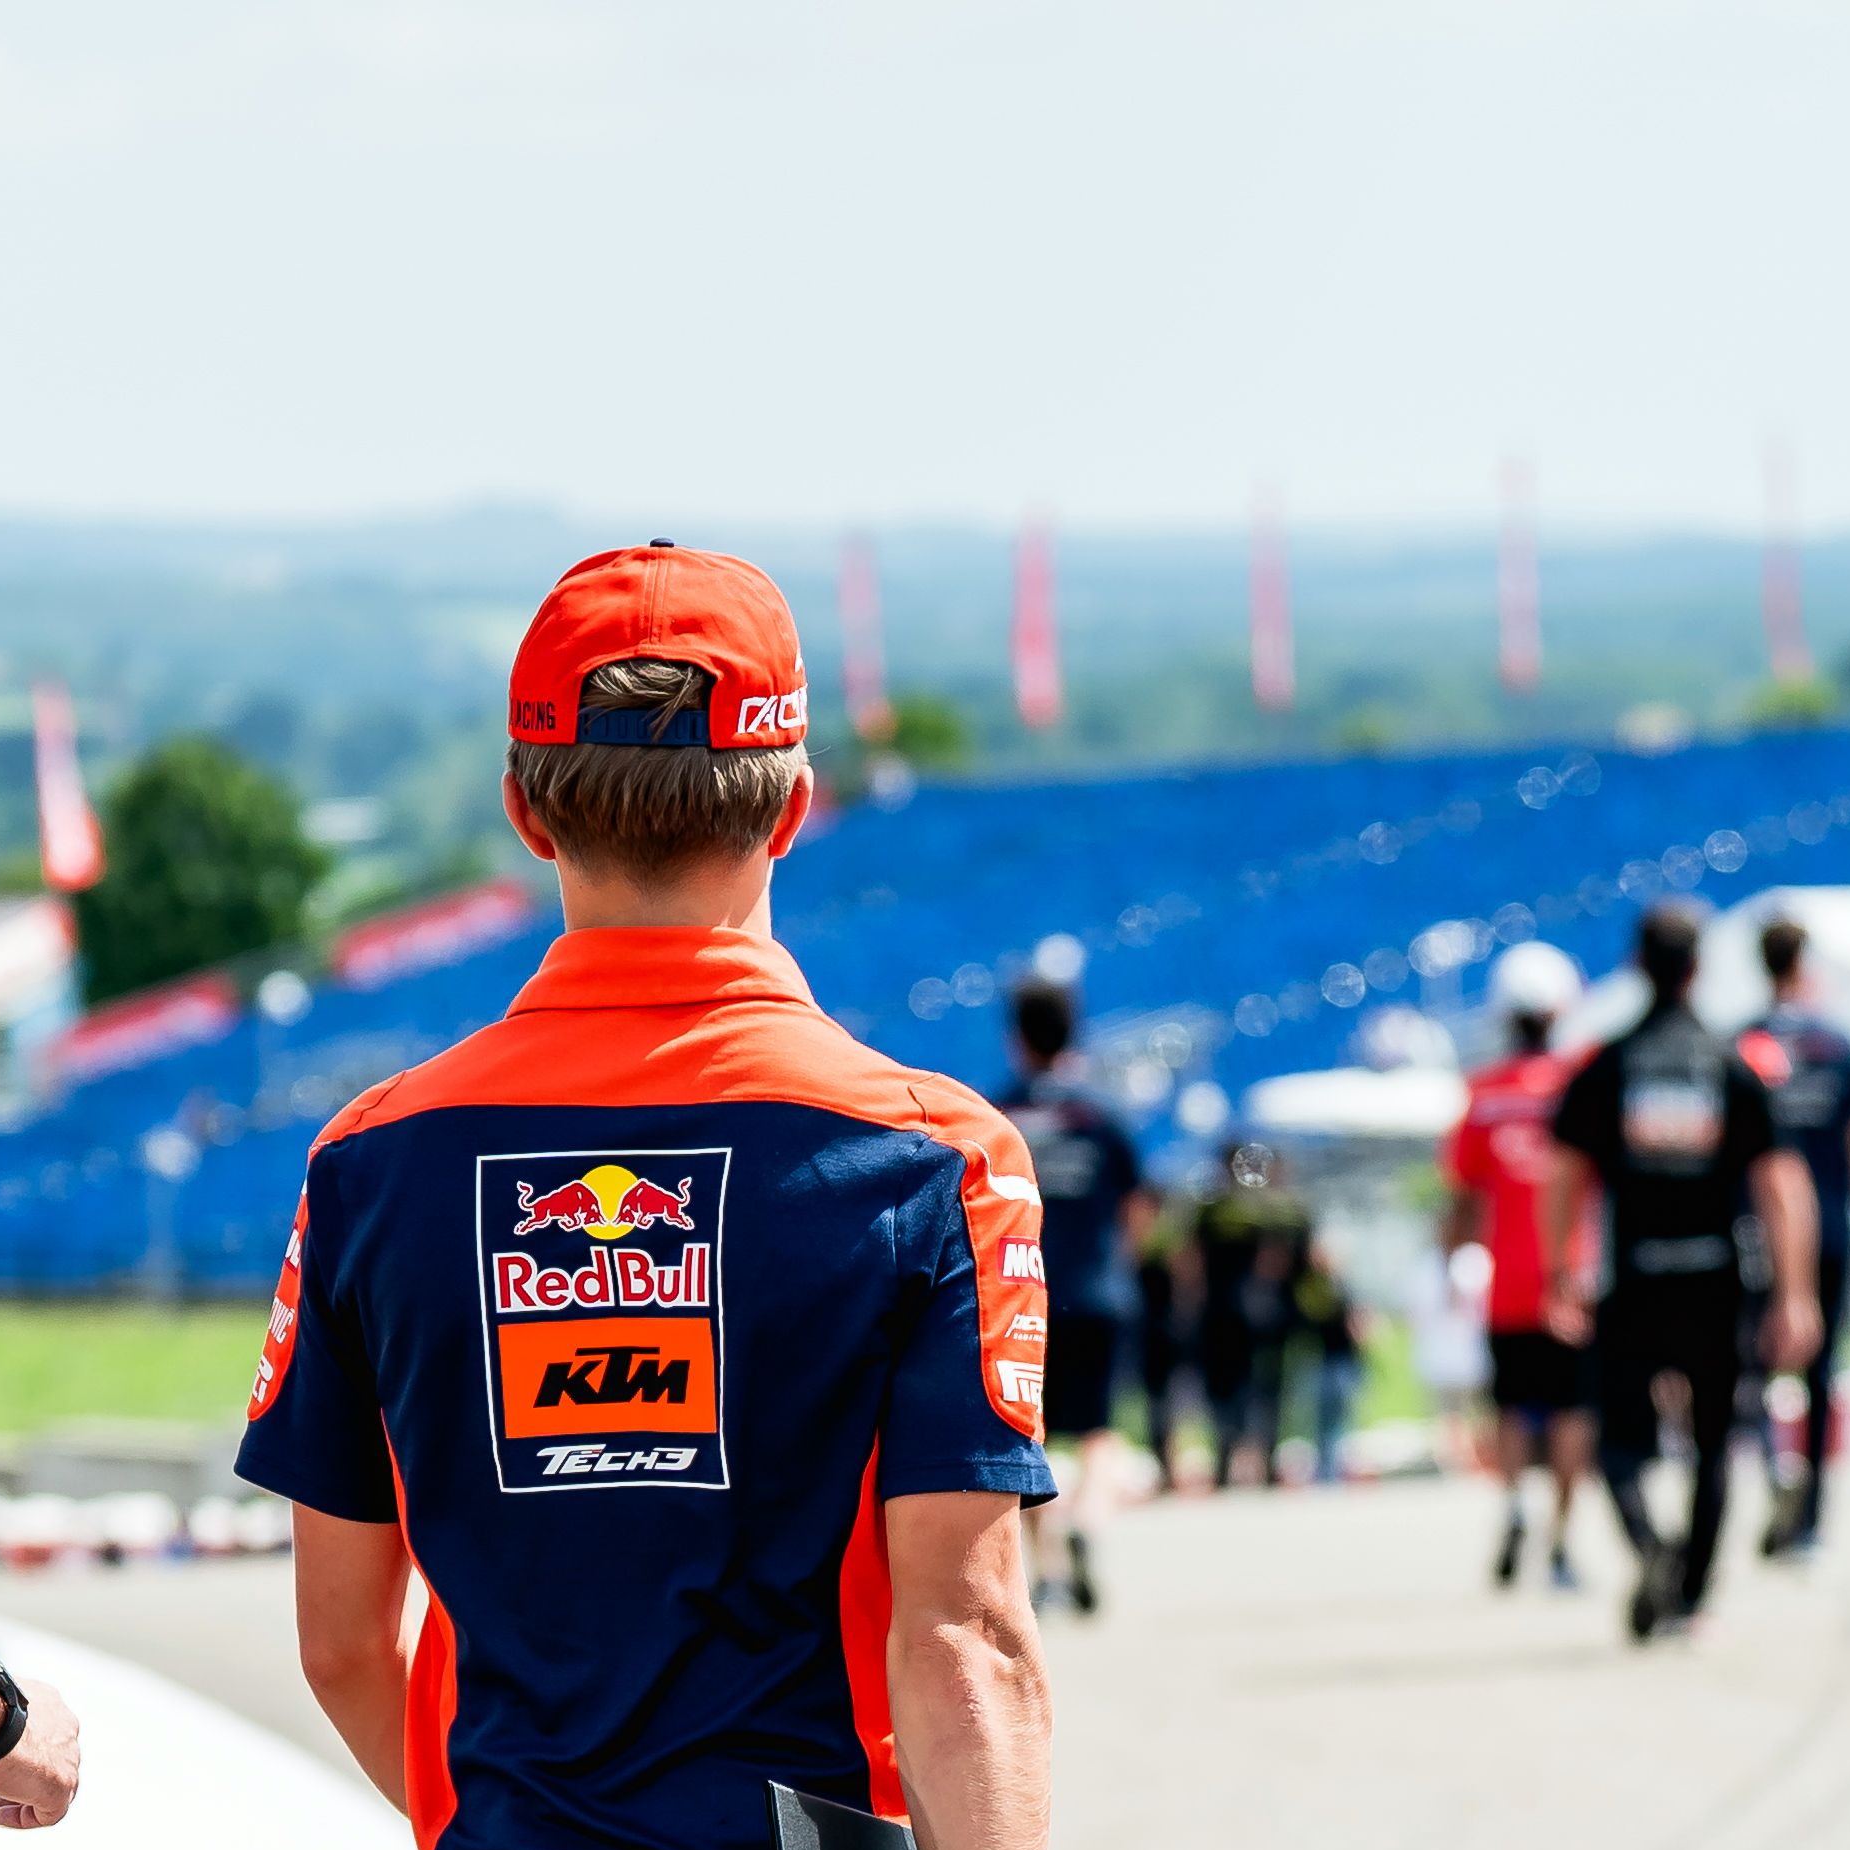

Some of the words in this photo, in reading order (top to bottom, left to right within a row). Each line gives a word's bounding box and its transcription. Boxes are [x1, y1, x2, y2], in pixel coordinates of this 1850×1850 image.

[509, 699, 556, 731] ACING
[494, 1247, 613, 1312] Red
[614, 1244, 709, 1307] Bull
[533, 1346, 690, 1408] KTM
